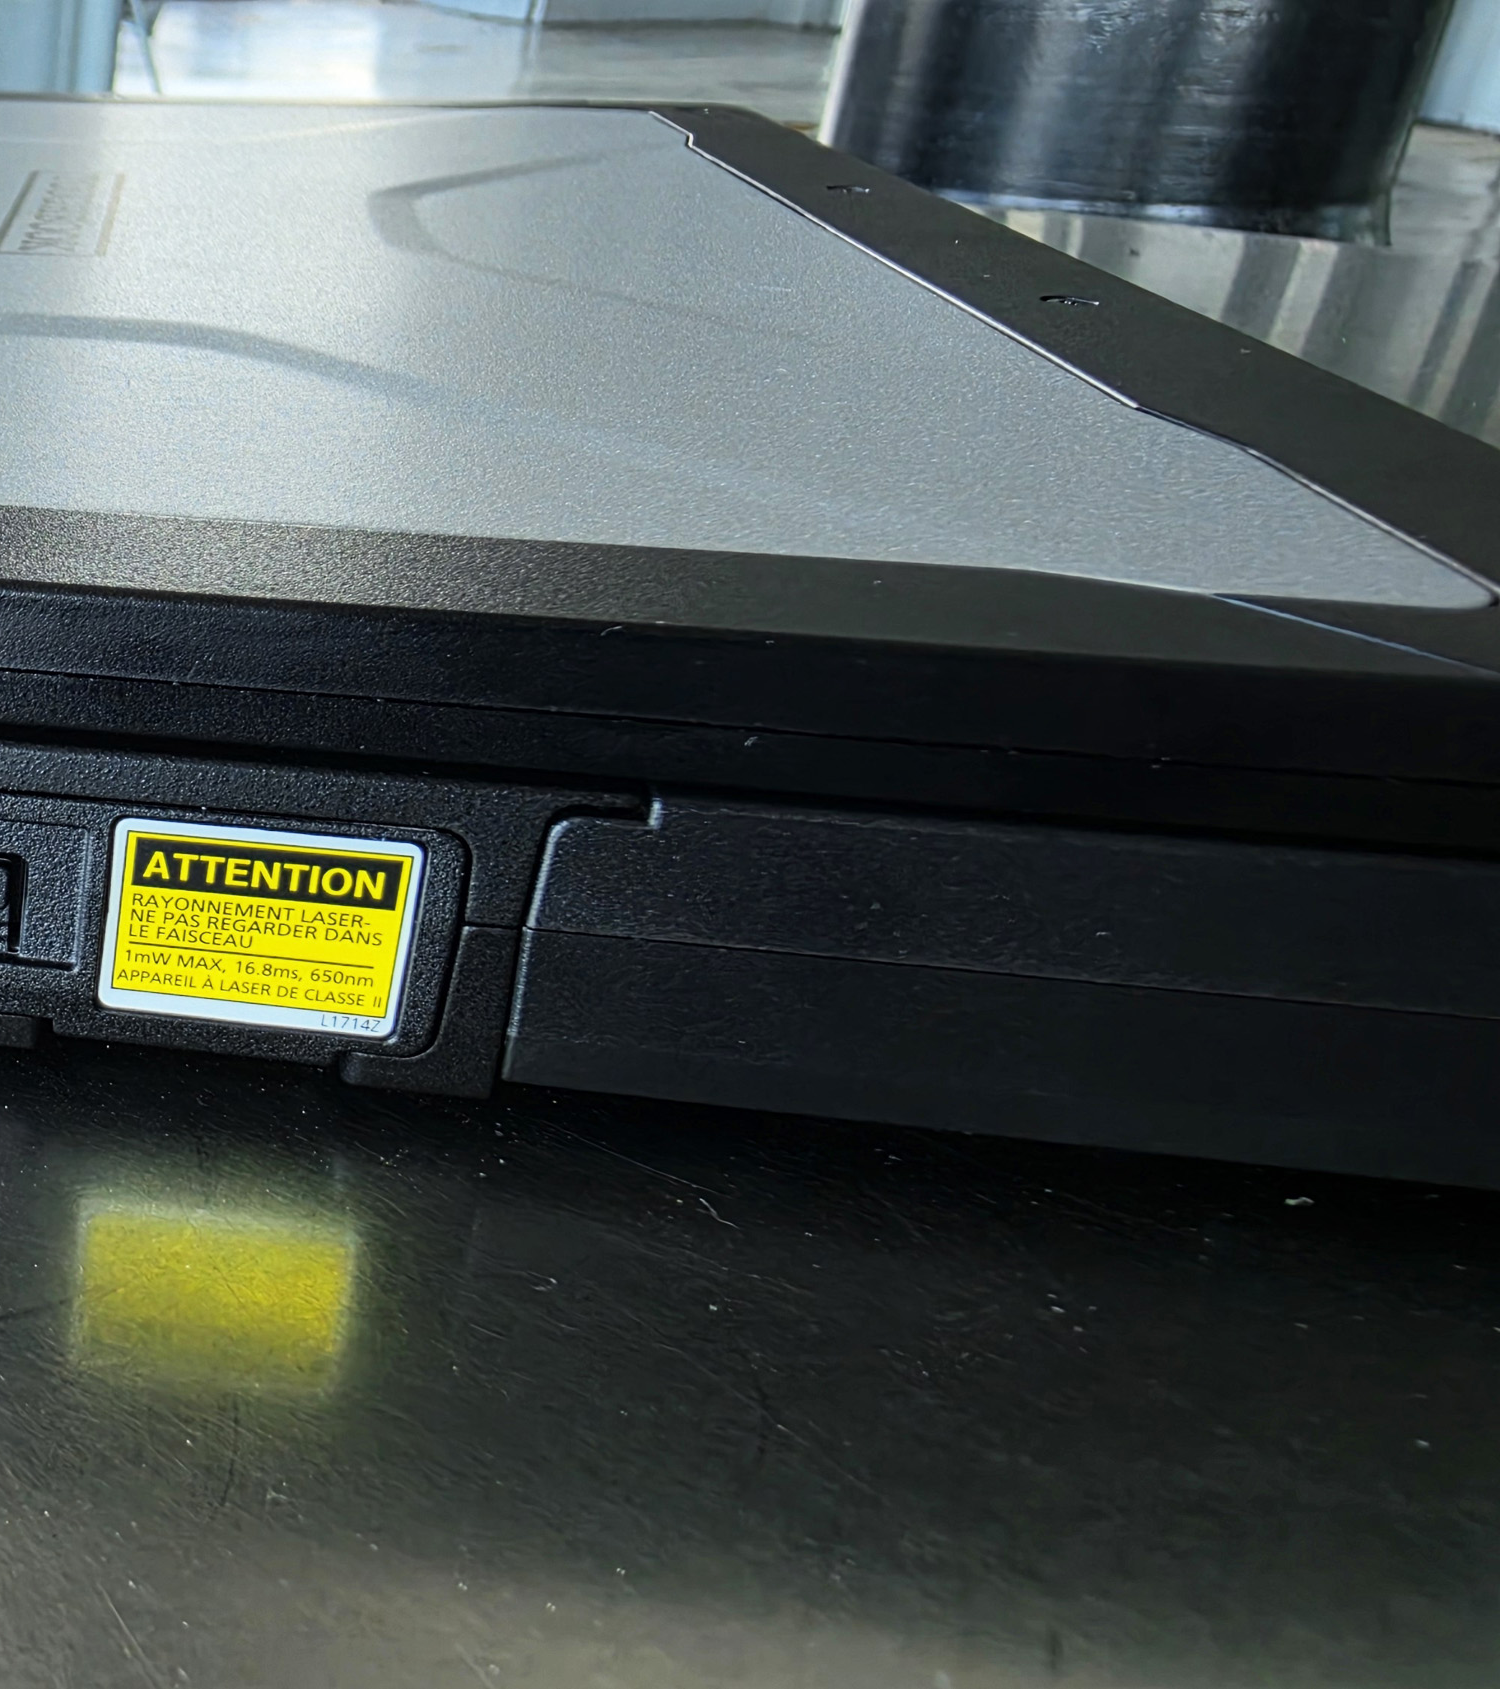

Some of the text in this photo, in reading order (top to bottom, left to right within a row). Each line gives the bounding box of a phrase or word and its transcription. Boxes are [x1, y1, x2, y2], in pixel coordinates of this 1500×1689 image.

[142, 851, 385, 900] ATTENTION
[130, 910, 382, 946] NE PAS REGARDER DANS
[132, 893, 371, 928] RAYONNEMENT LASER-
[129, 924, 253, 949] LE FAISCEAU
[126, 949, 374, 987] 1mW MAX, 16.8ms, 650nm
[117, 969, 382, 1008] APPAREIL À LASER DE CLASSE II
[321, 1014, 380, 1032] L1714Z
